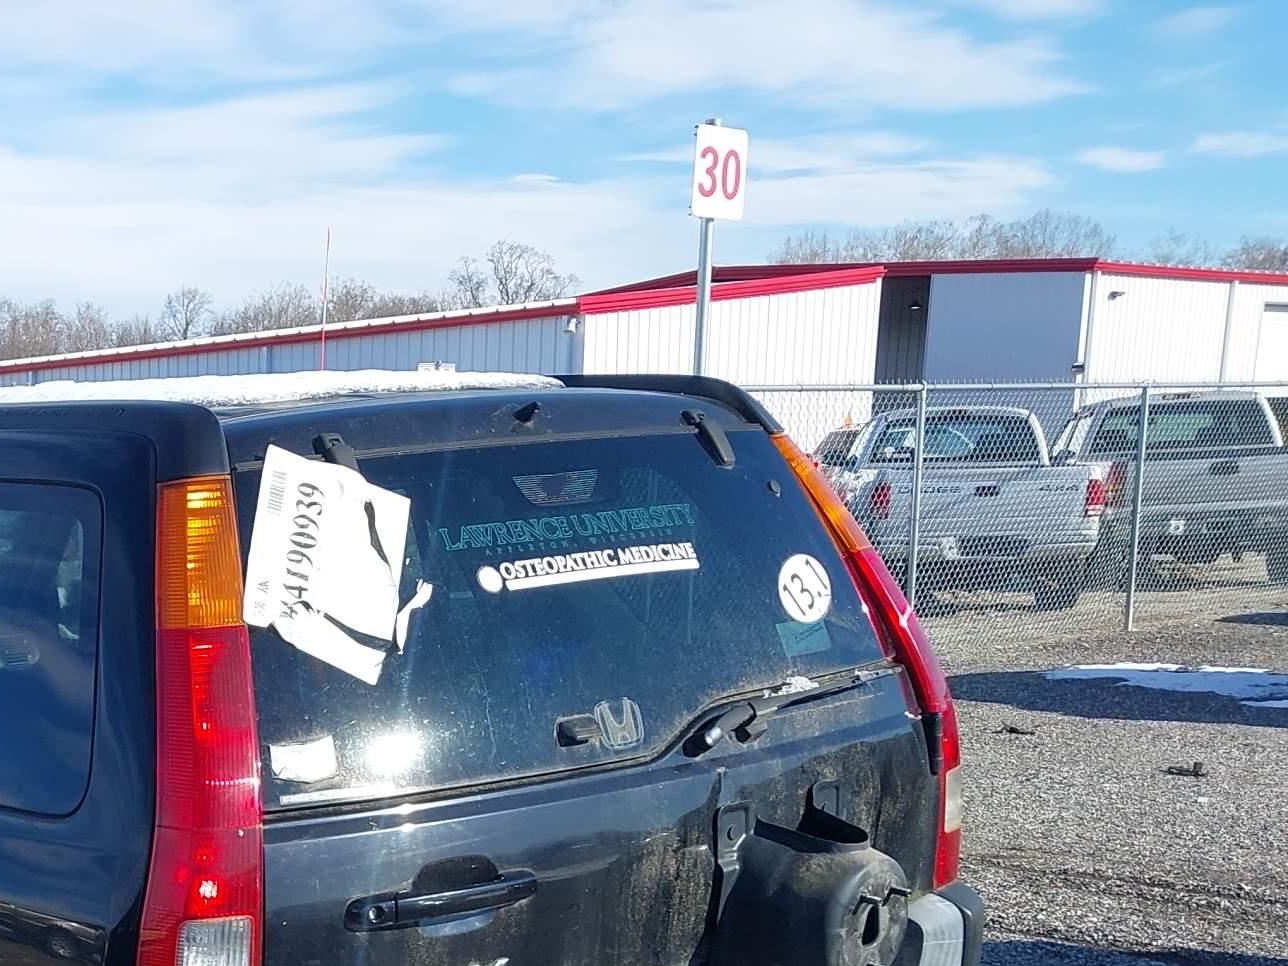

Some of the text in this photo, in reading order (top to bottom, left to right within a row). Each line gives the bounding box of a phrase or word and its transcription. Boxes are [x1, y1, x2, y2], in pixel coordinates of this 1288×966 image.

[698, 146, 740, 200] 30
[897, 485, 962, 495] DDGE
[439, 503, 696, 551] LAWRENCE UNIVERSITY
[499, 542, 698, 580] OSTEOPATHIC MEDICINE
[783, 557, 828, 616] 13.1
